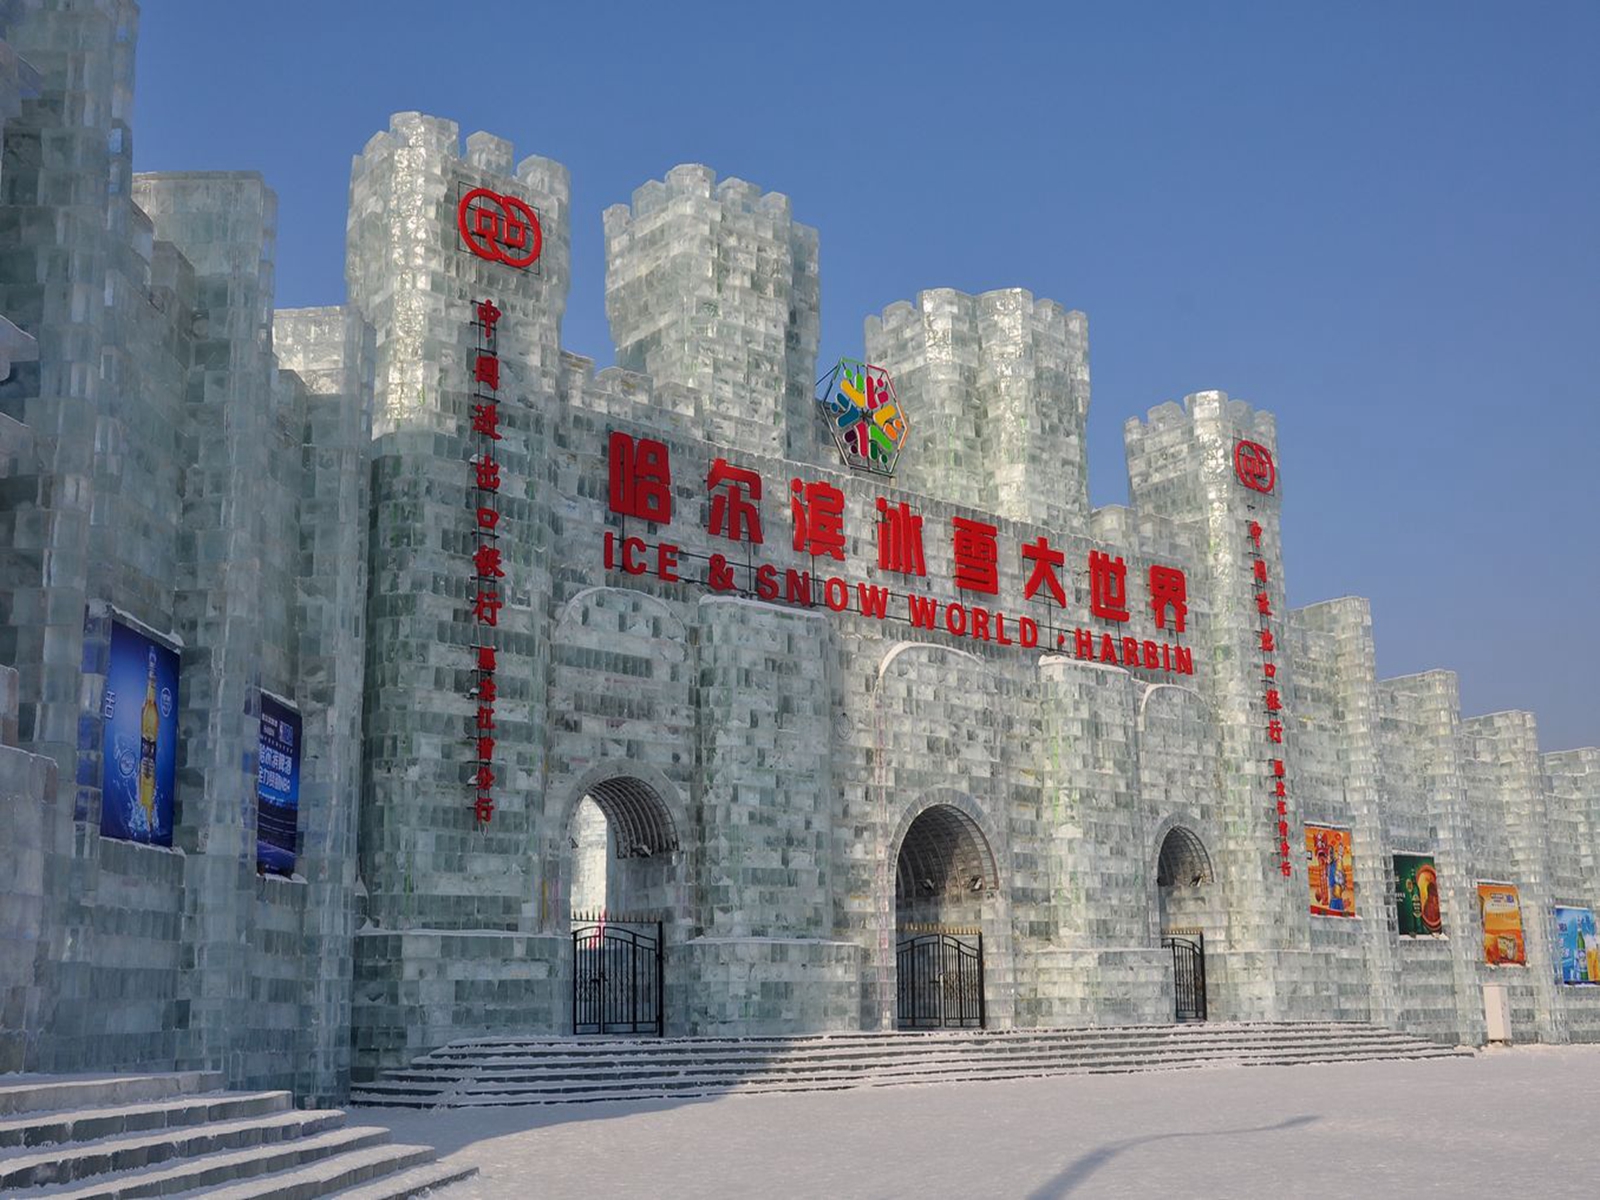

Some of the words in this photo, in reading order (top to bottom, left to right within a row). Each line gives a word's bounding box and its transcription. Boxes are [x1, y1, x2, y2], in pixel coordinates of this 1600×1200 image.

[604, 531, 679, 582] ICE
[708, 554, 738, 591] &
[756, 564, 888, 620] SNOW
[908, 593, 1038, 648] WORLD
[608, 430, 1188, 632] 哈尔滨冰雪大世界
